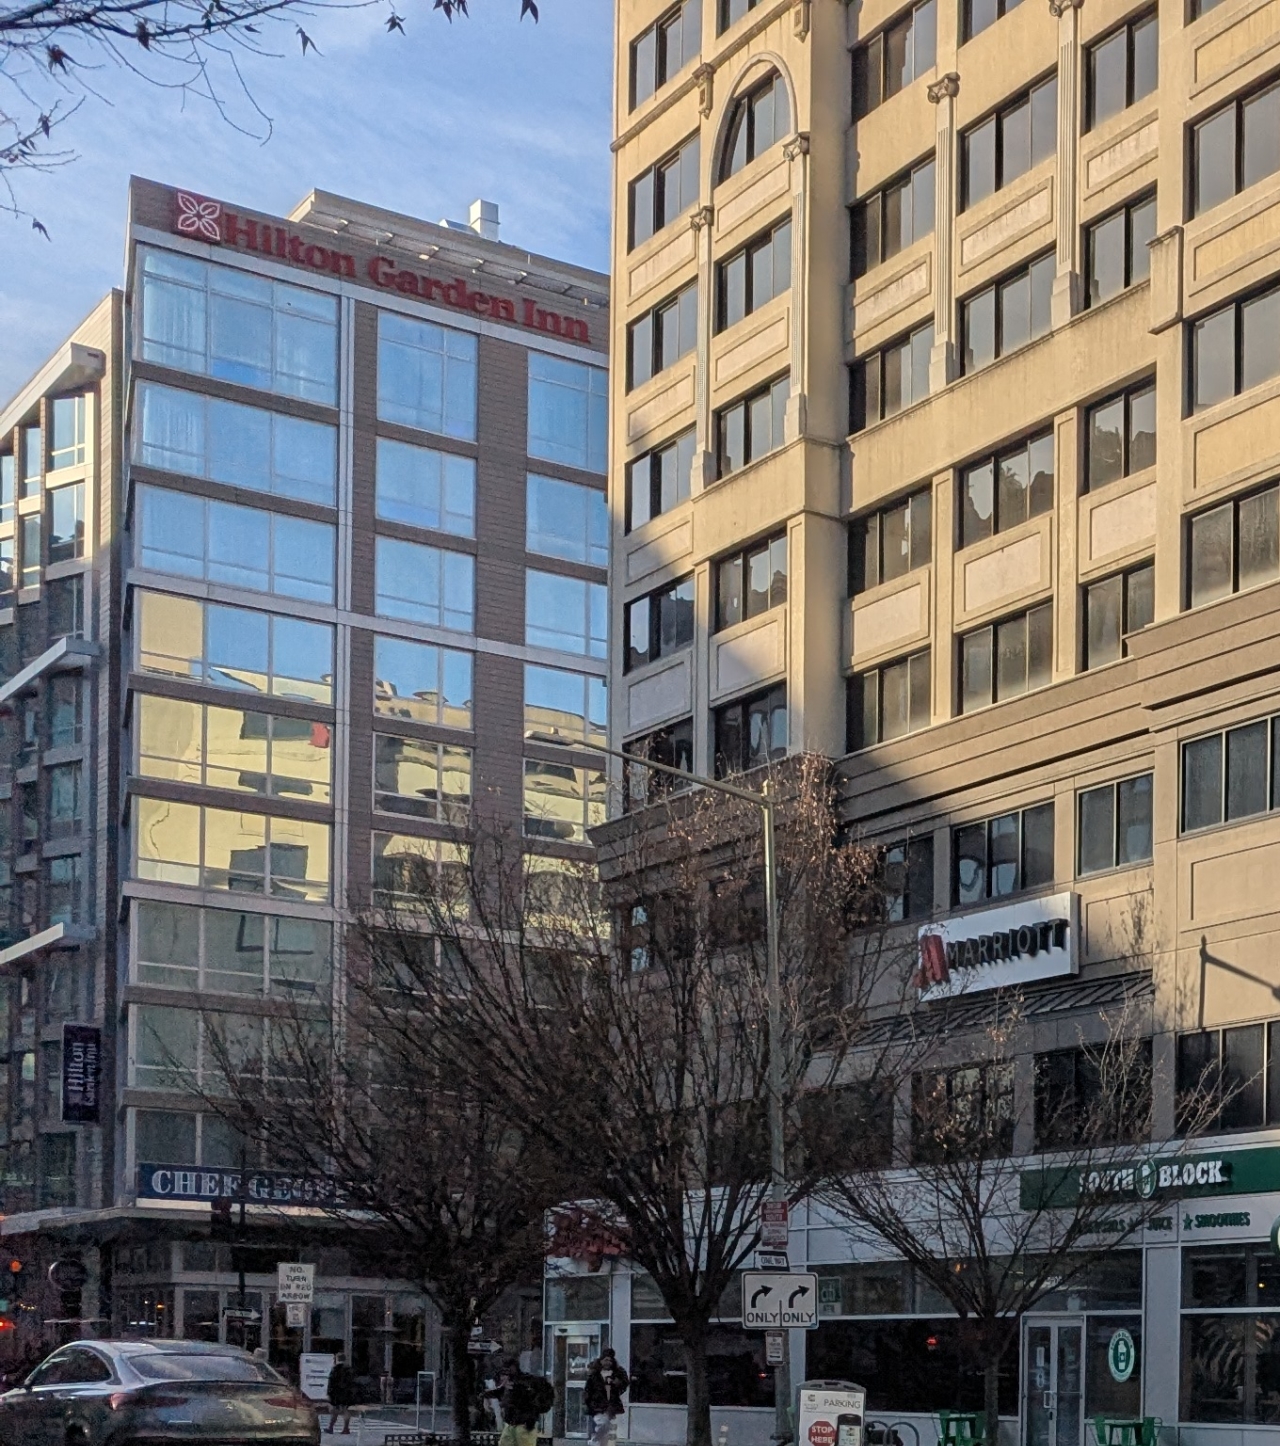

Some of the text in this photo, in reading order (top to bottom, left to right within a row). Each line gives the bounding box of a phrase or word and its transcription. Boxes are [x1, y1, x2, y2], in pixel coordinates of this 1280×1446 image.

[225, 212, 591, 344] Hilton Garden Inn
[946, 917, 1069, 972] MARRIOTT
[67, 1042, 84, 1091] Hilton
[151, 1170, 241, 1197] CHEF
[1159, 1160, 1223, 1188] BLOCK
[1194, 1212, 1251, 1228] SMOOTHIES
[746, 1312, 815, 1323] ONLY ONLY
[823, 1399, 860, 1409] PARKING
